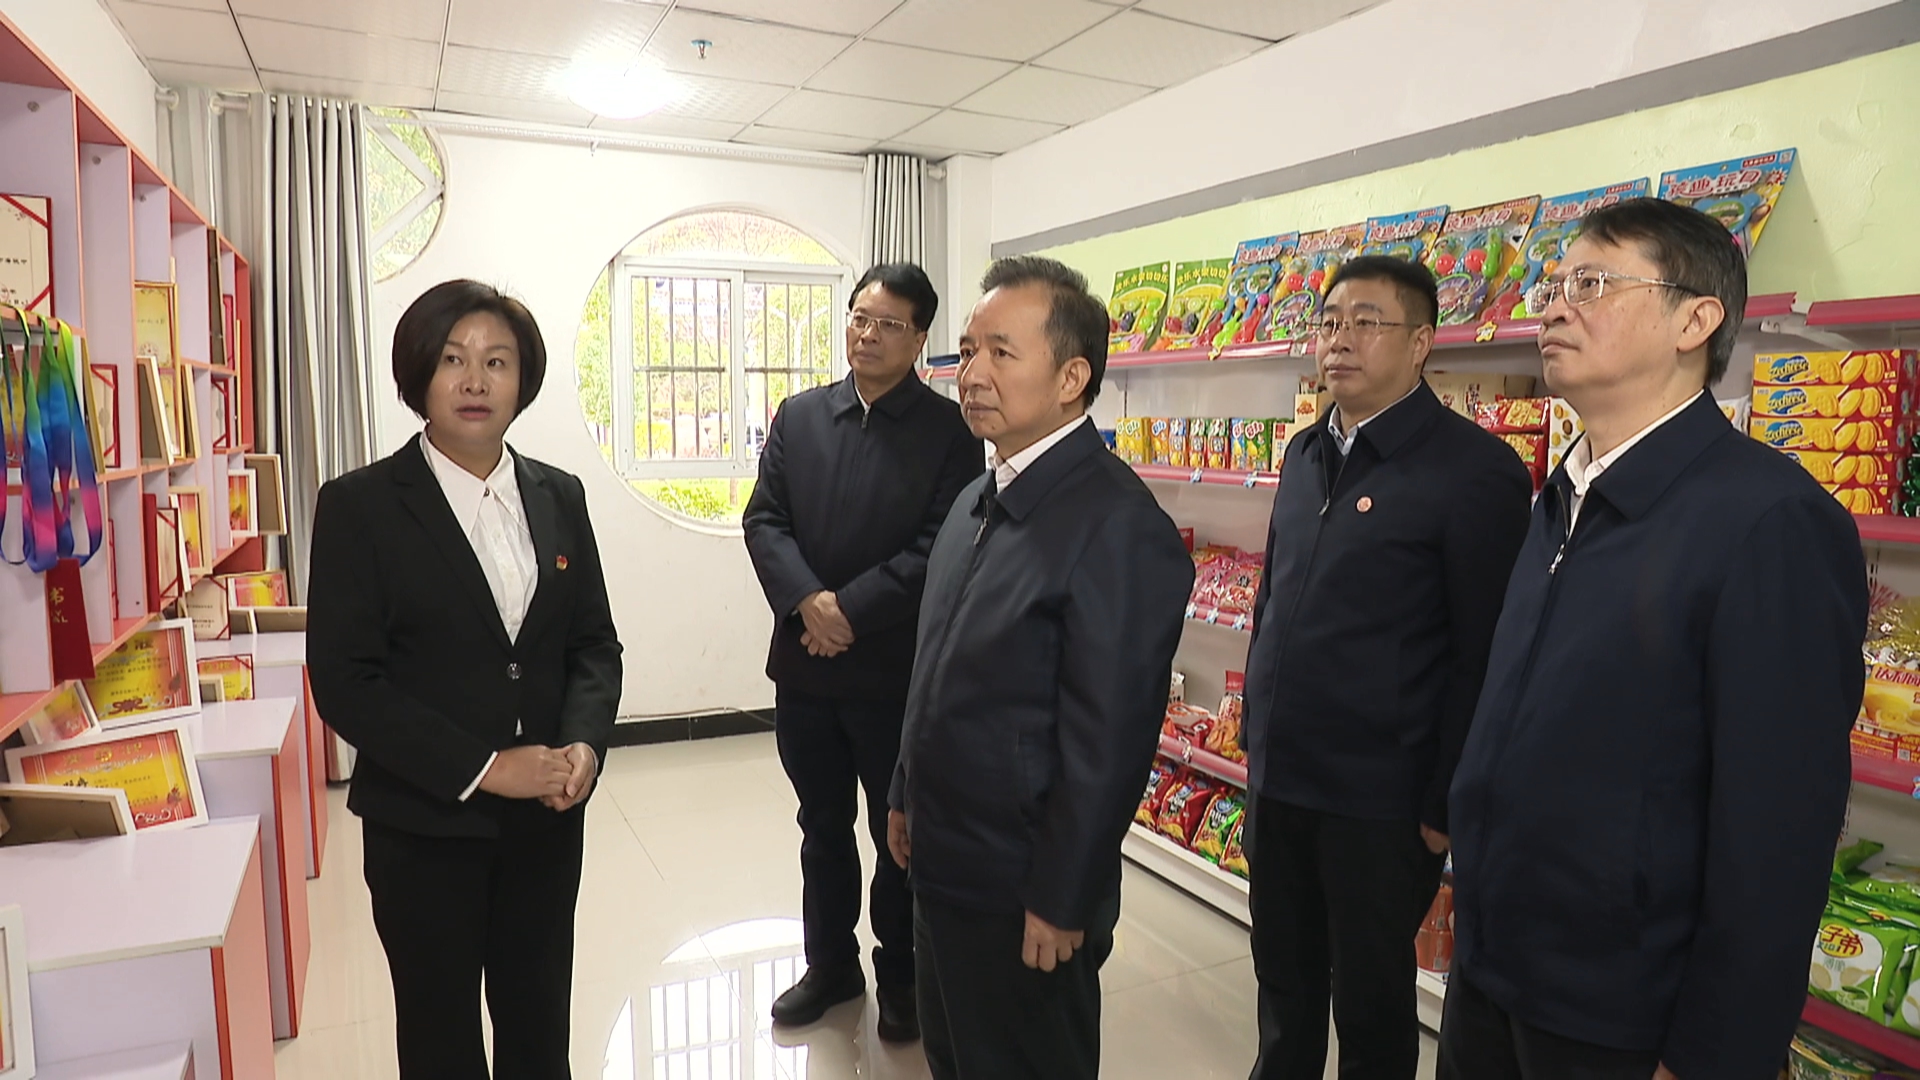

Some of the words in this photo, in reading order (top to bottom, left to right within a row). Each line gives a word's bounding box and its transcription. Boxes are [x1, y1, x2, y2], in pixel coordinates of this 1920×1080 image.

[1177, 266, 1227, 286] 欢乐水果切切
[1821, 925, 1861, 956] 子弟
